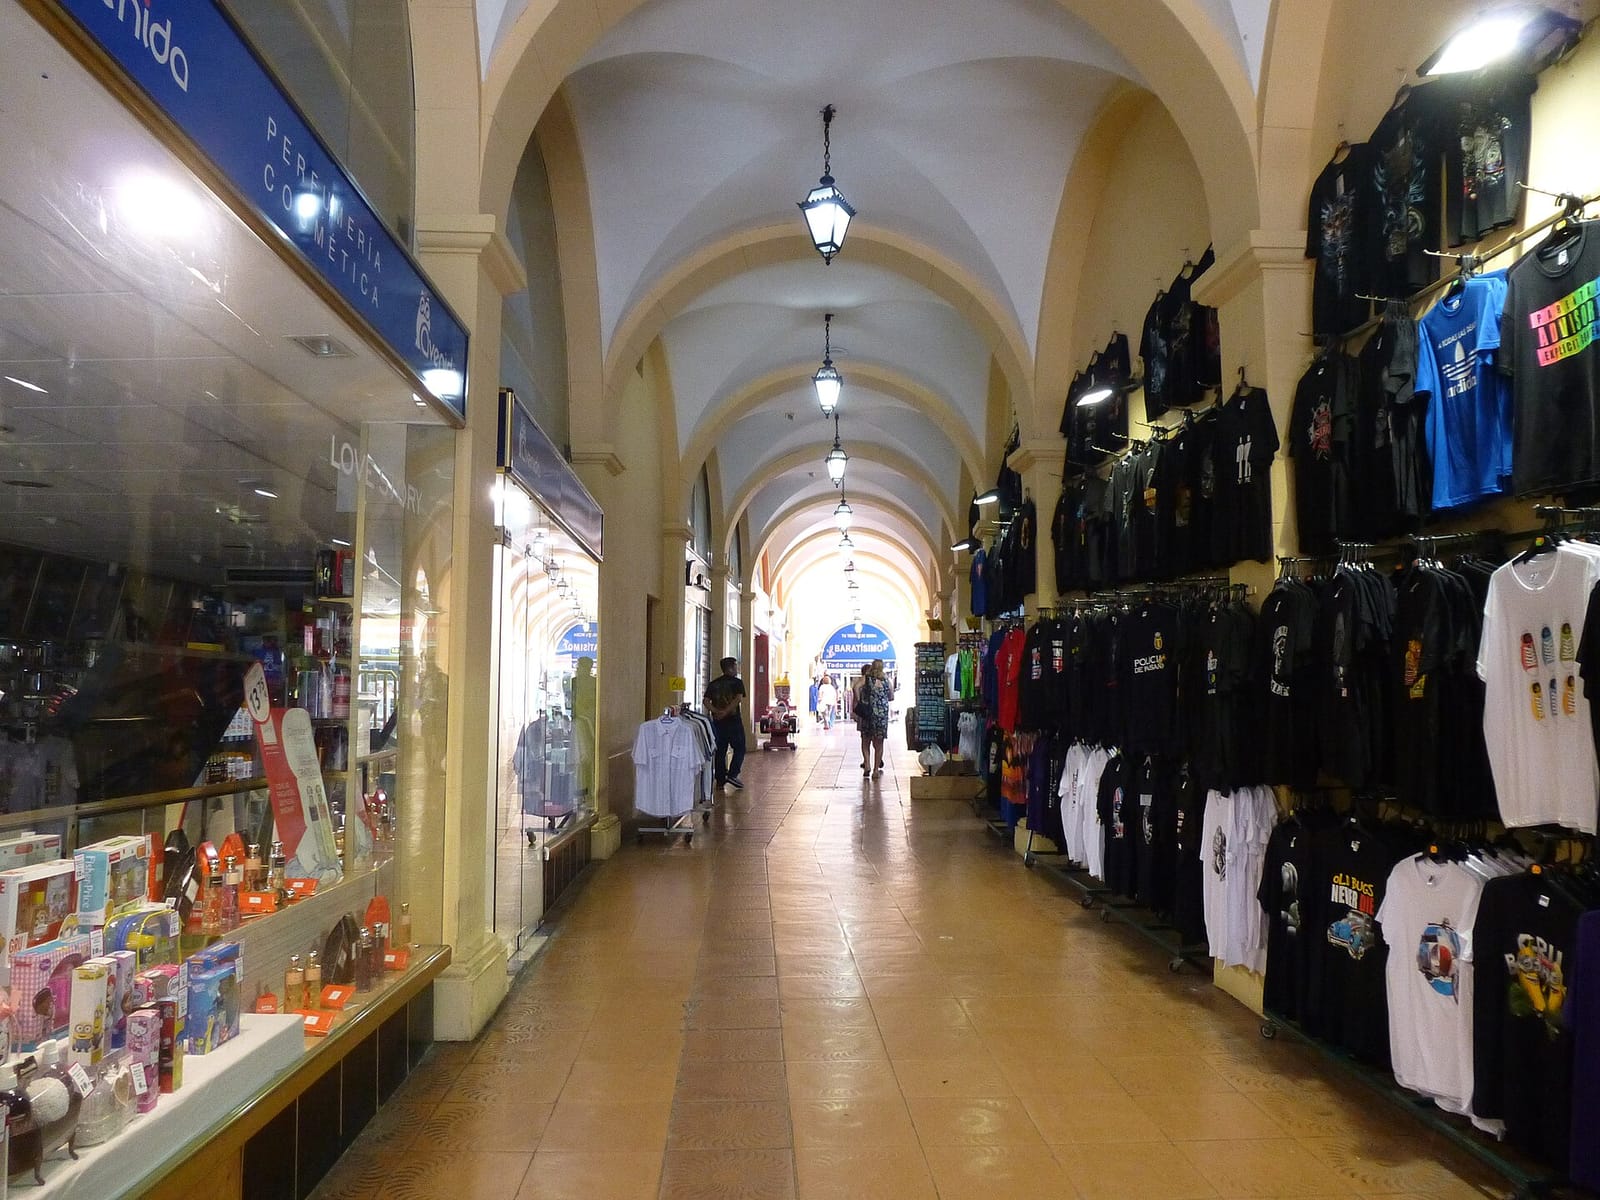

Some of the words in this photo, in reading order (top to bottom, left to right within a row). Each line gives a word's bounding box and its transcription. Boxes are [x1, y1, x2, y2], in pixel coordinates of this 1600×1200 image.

[264, 164, 379, 309] COMÉTICA
[834, 642, 883, 653] BARATÍSIMO
[1351, 876, 1374, 897] BUGS
